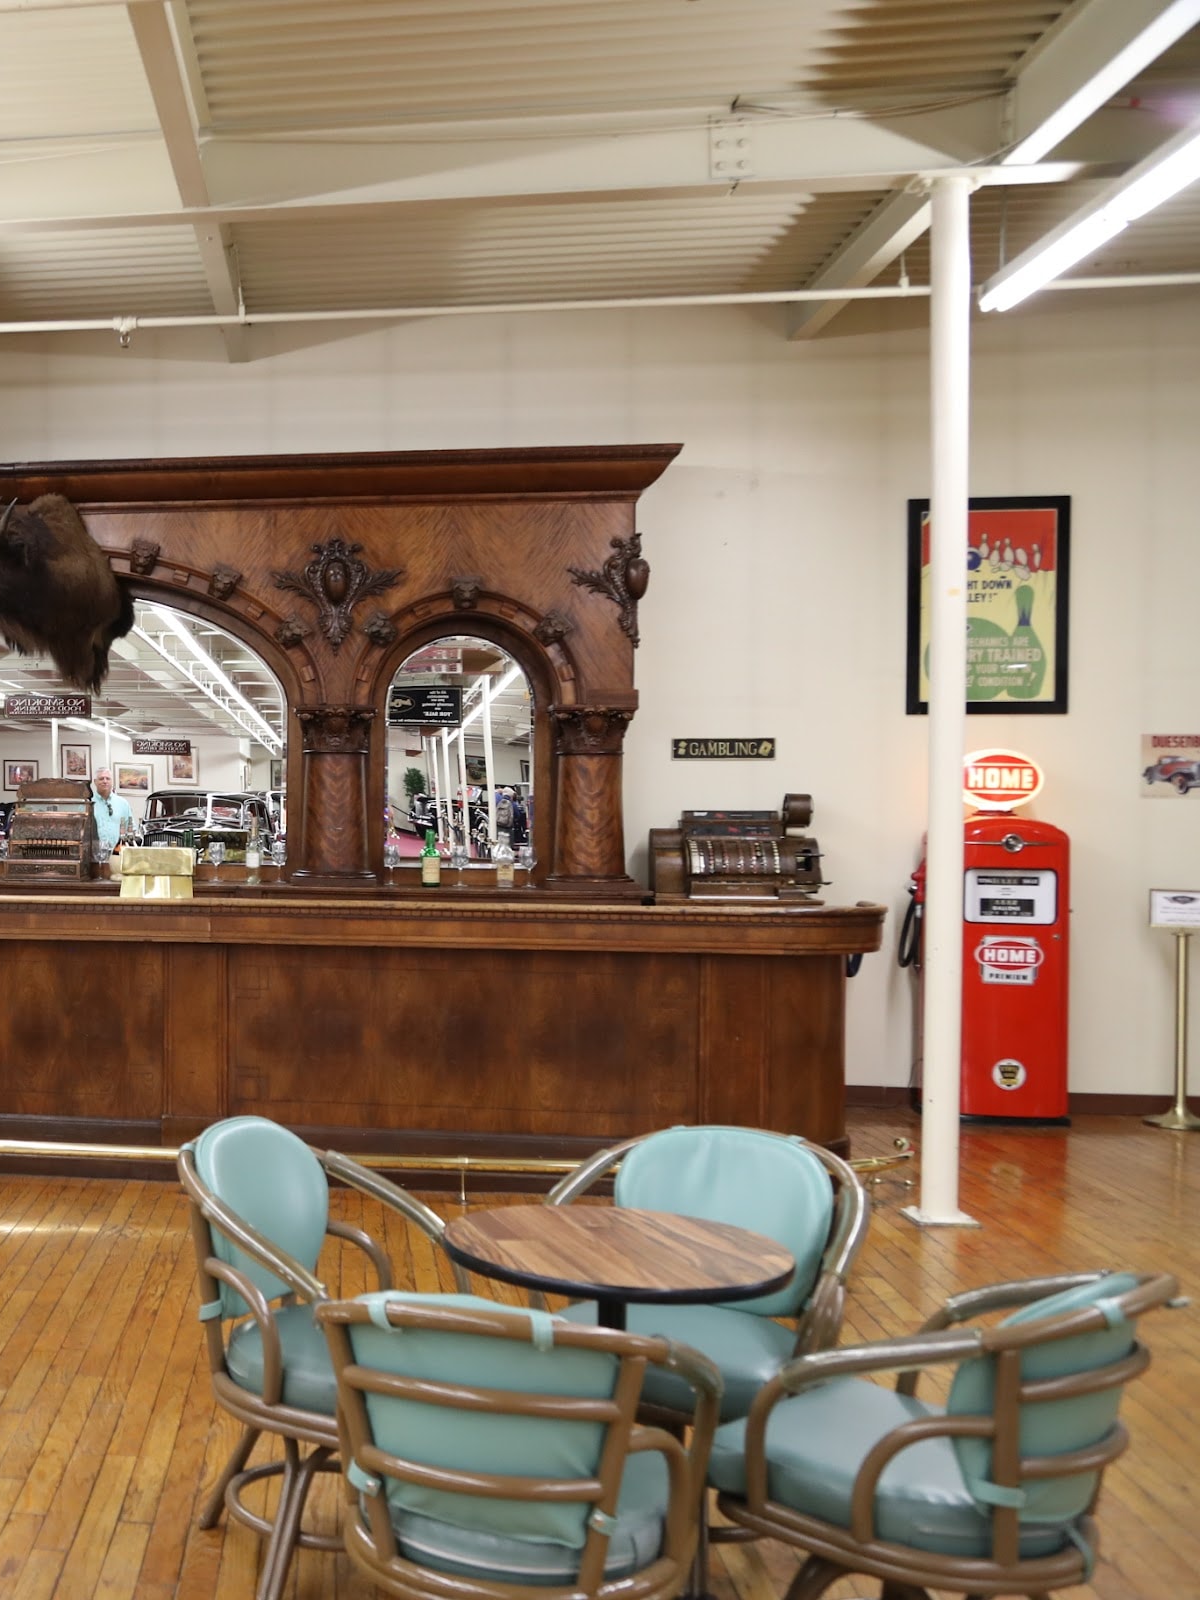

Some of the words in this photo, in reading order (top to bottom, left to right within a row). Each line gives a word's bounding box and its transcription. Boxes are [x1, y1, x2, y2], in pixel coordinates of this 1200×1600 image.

[982, 580, 1012, 590] DOWN
[987, 648, 1042, 662] TRAINED
[689, 741, 758, 756] GAMBLING
[967, 768, 1034, 789] HOME
[983, 949, 1036, 963] HOME
[989, 973, 1028, 981] PREMIUM
